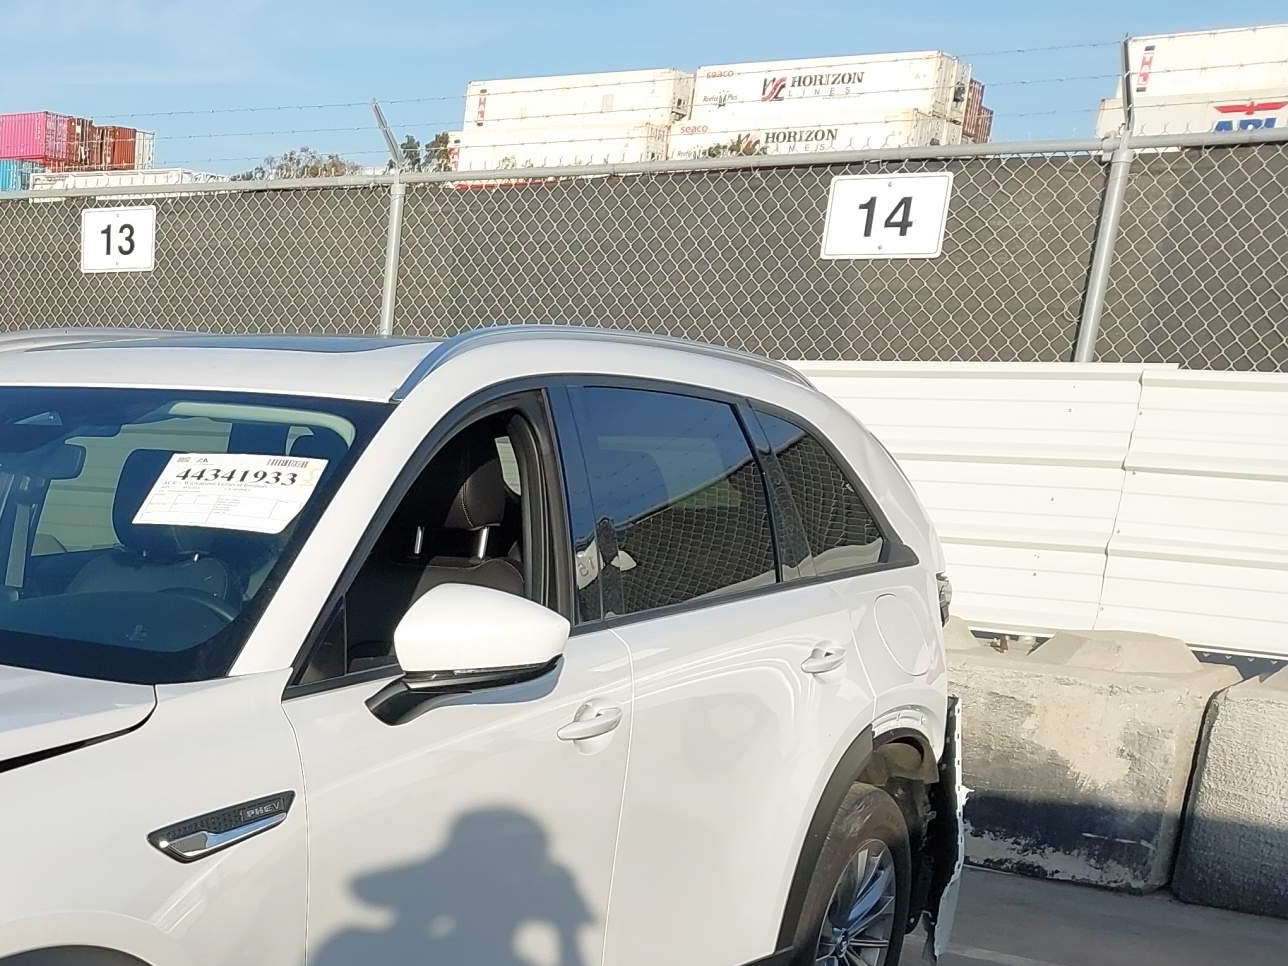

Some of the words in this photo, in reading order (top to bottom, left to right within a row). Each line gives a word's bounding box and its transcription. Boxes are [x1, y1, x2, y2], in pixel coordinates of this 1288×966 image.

[791, 71, 865, 88] HORIZON
[788, 86, 851, 97] LINES
[680, 125, 709, 134] seaco
[765, 128, 838, 144] HORIZON
[775, 142, 826, 153] INES
[858, 196, 914, 237] 14
[100, 223, 135, 256] 13
[175, 467, 299, 487] 44341933
[246, 801, 280, 816] PHEV
